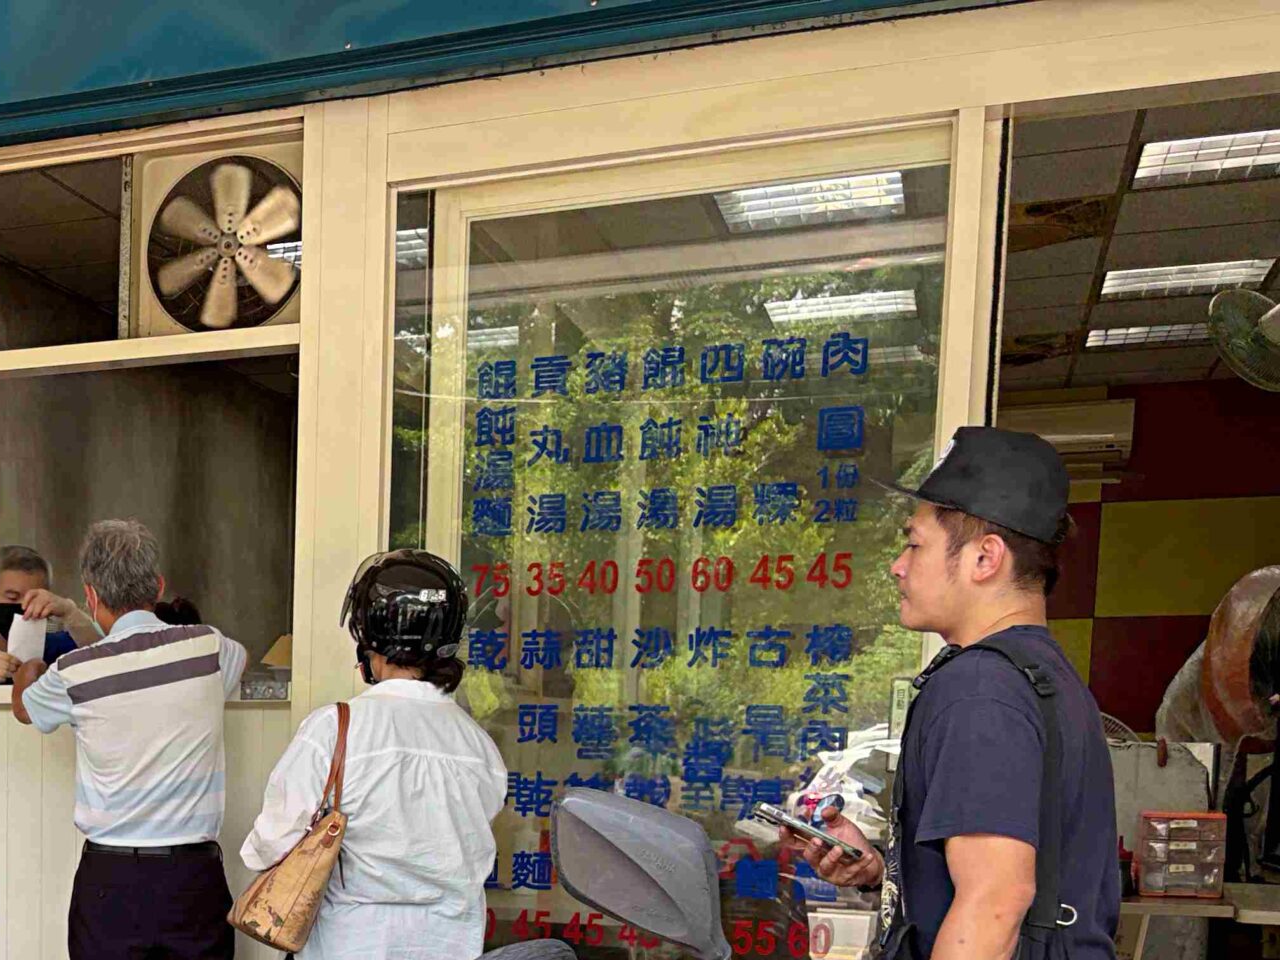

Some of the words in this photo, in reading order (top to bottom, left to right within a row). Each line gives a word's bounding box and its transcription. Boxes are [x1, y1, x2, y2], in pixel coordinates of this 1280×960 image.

[471, 564, 512, 598] 75
[526, 562, 566, 596] 35
[578, 560, 619, 595] 40
[634, 558, 676, 594] 50
[691, 556, 735, 593] 60
[749, 555, 795, 591] 45
[806, 553, 854, 590] 45
[512, 910, 552, 940] 45
[563, 912, 605, 947] 45
[732, 919, 776, 956] 55
[787, 922, 831, 959] 60
